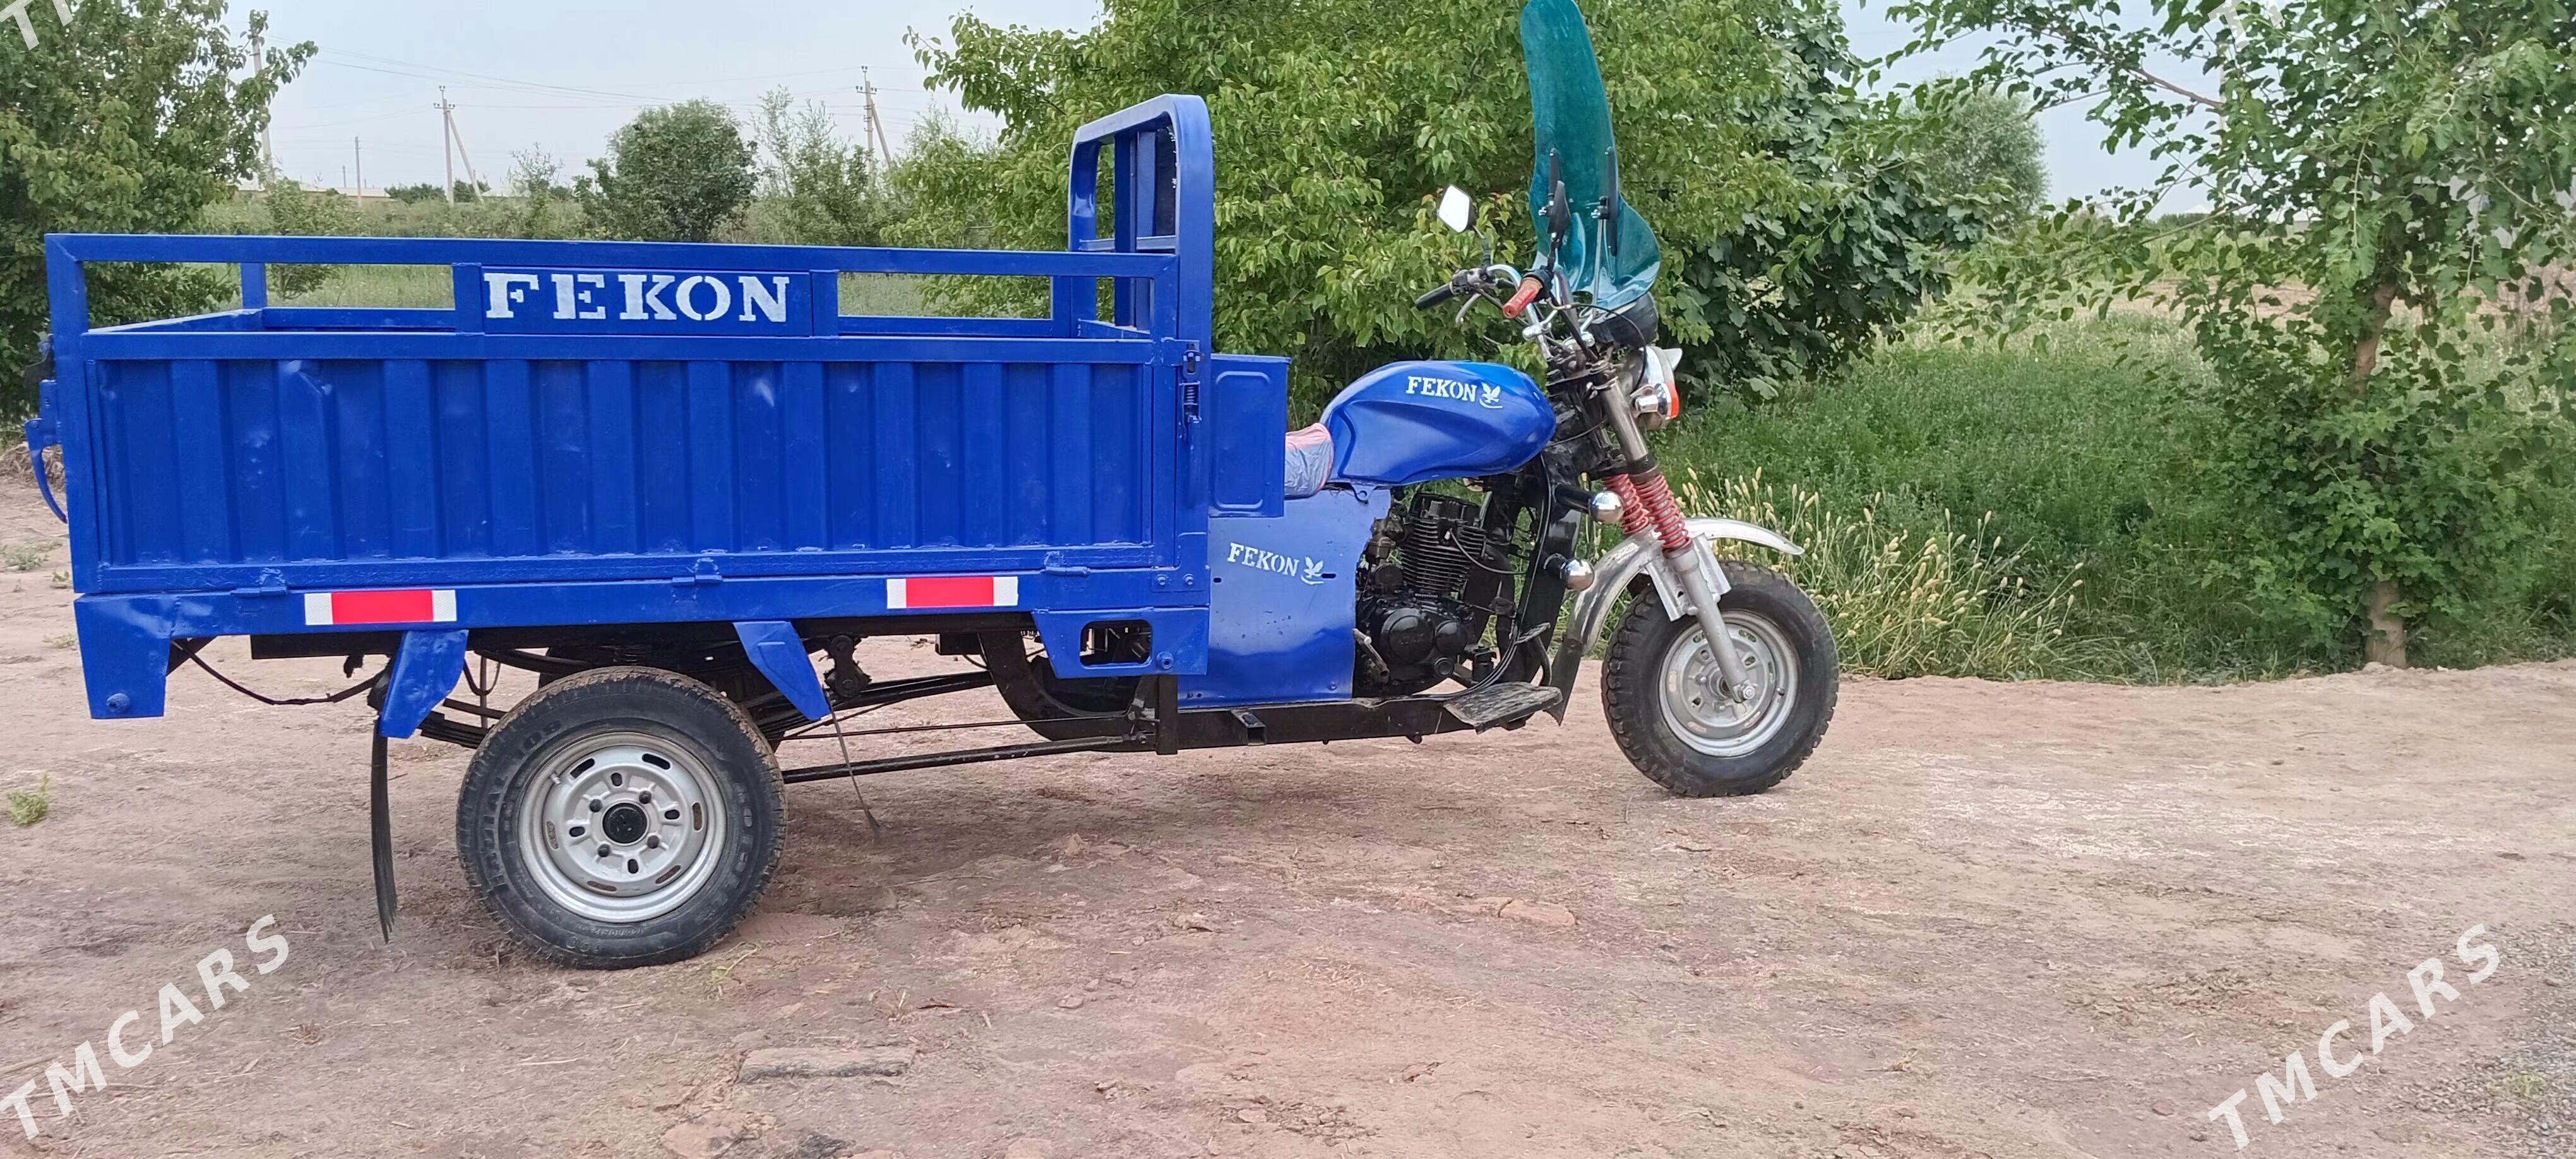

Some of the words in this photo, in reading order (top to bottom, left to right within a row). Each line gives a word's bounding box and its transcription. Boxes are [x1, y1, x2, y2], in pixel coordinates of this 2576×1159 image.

[484, 273, 789, 322] FEKON
[1406, 376, 1477, 401] FEKON
[1227, 542, 1299, 577] FEKON
